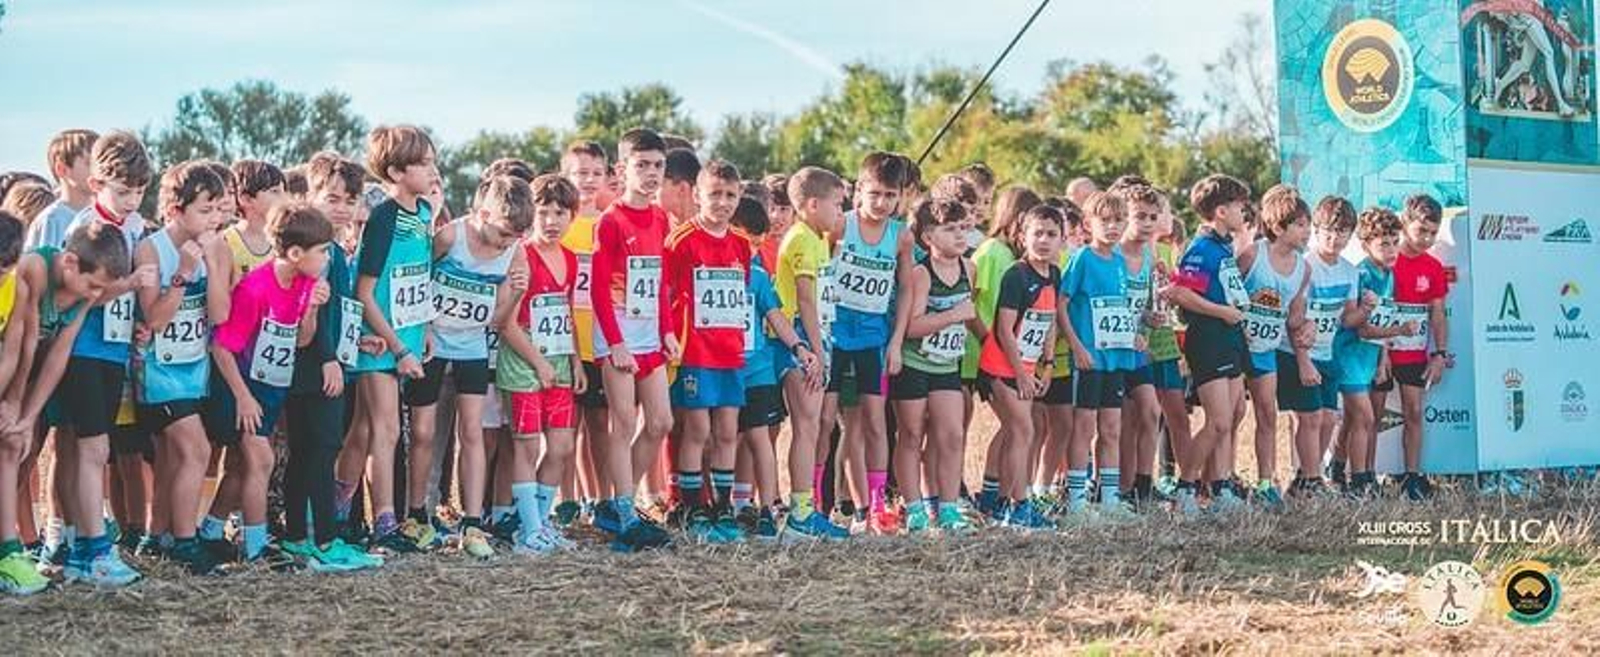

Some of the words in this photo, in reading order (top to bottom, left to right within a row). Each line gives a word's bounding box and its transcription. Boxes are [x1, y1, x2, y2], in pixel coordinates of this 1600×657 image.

[396, 283, 428, 307] 415
[838, 272, 889, 296] 4200
[432, 293, 489, 323] 4230
[261, 344, 297, 367] 42
